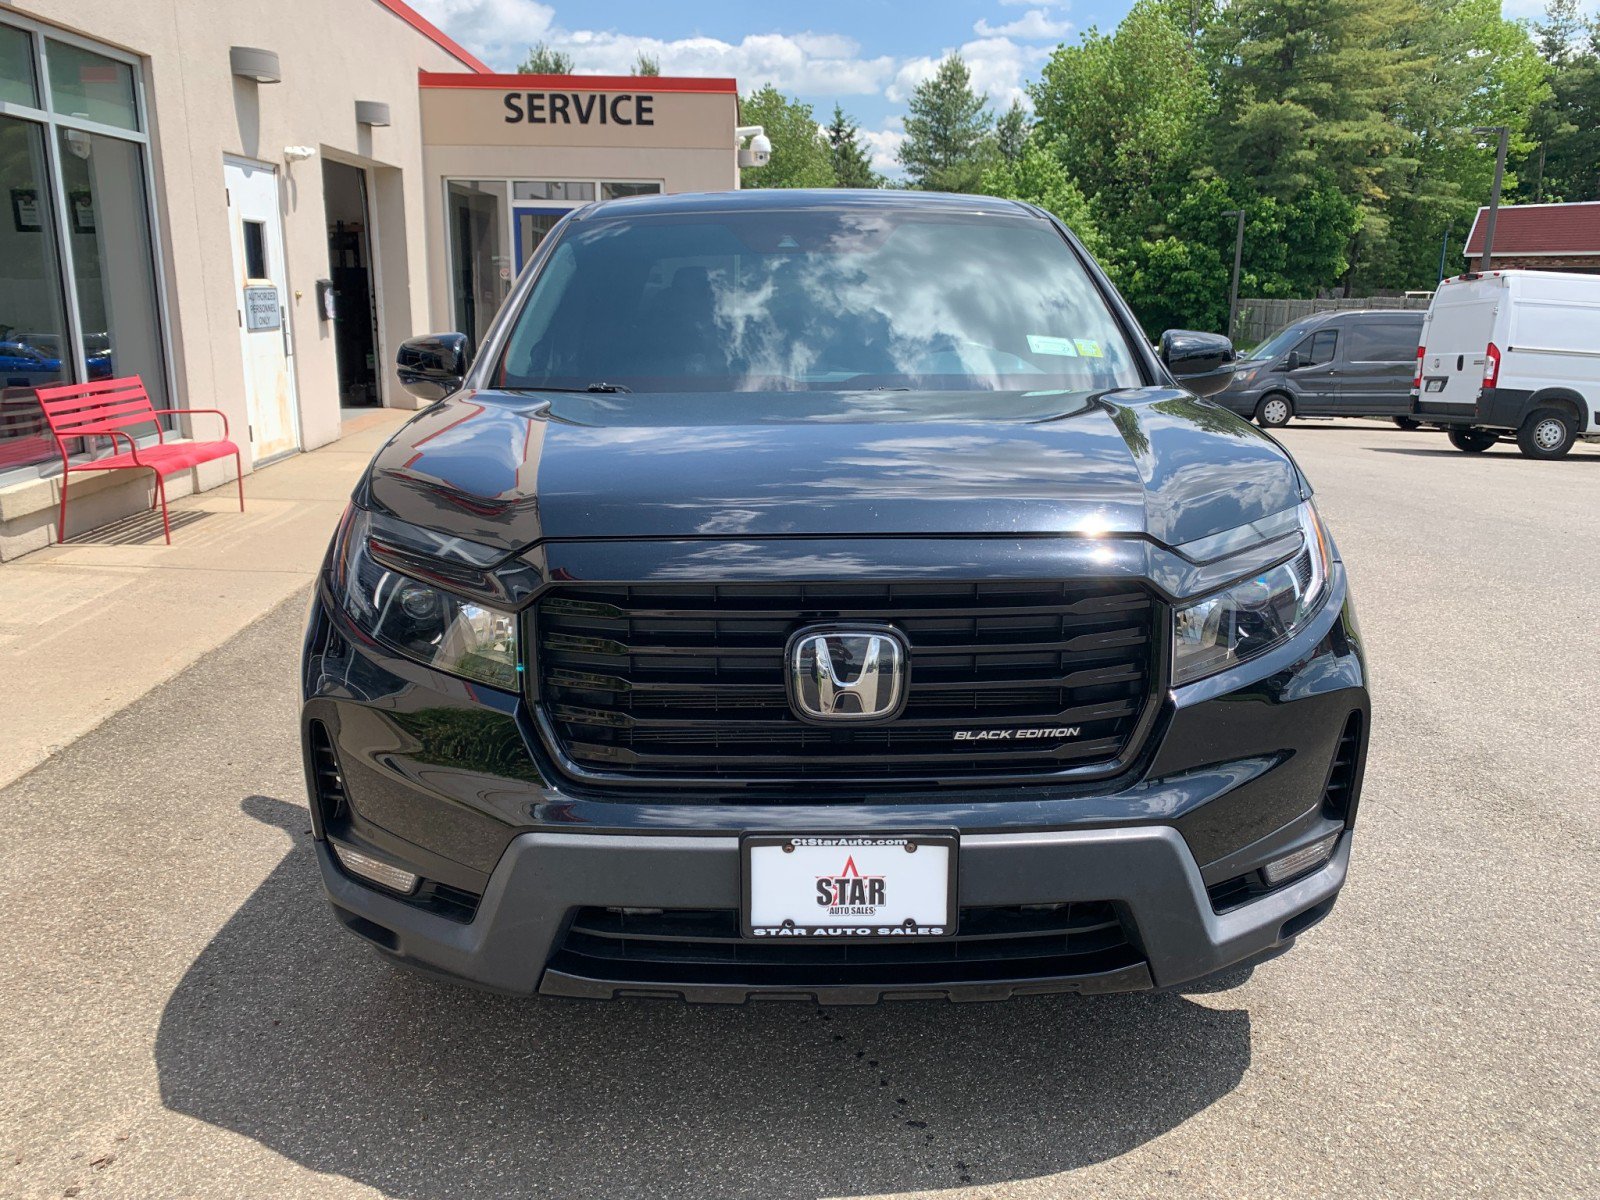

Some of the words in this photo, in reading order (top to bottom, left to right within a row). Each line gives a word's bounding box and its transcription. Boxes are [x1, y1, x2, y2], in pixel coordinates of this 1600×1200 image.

[503, 92, 654, 126] SERVICE
[248, 292, 275, 301] AUTHORIZED
[250, 304, 276, 313] PERSONNEL
[258, 316, 271, 325] ONLY
[953, 730, 1012, 740] BLACK
[1015, 727, 1081, 739] EDITION
[790, 838, 908, 846] CtStarAuto.com
[816, 878, 886, 906] STAR
[829, 906, 850, 915] AUTO
[851, 906, 875, 915] SALES
[753, 928, 807, 936] STAR
